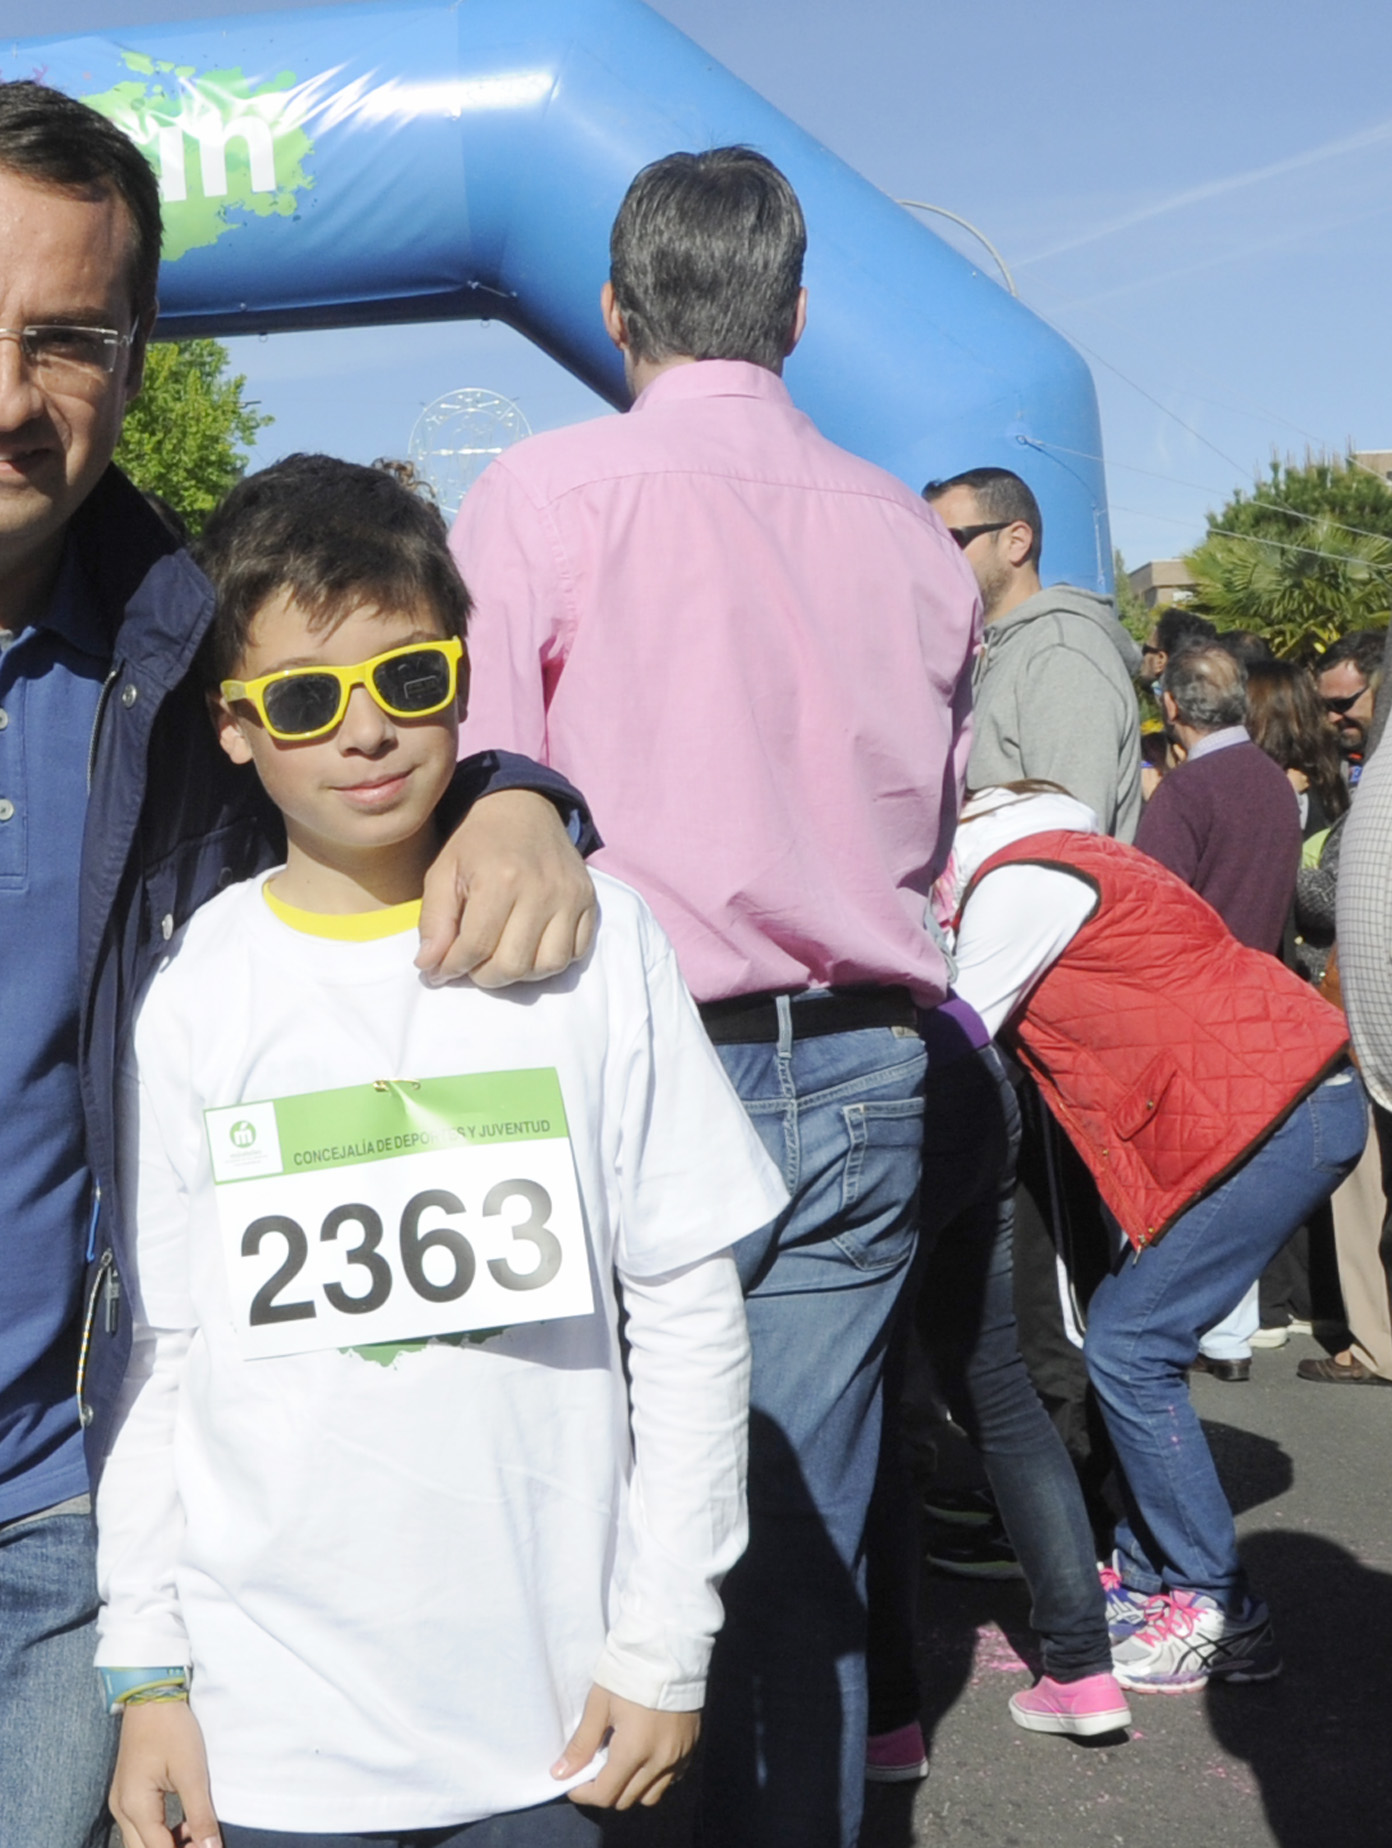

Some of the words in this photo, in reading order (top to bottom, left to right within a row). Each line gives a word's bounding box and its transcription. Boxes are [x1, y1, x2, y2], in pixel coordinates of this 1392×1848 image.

[292, 1138, 375, 1167] CONCEJALÍA
[377, 1136, 393, 1152] DE
[467, 1124, 477, 1139] Y
[479, 1119, 552, 1139] JUVENTUD
[240, 1178, 564, 1328] 2363
